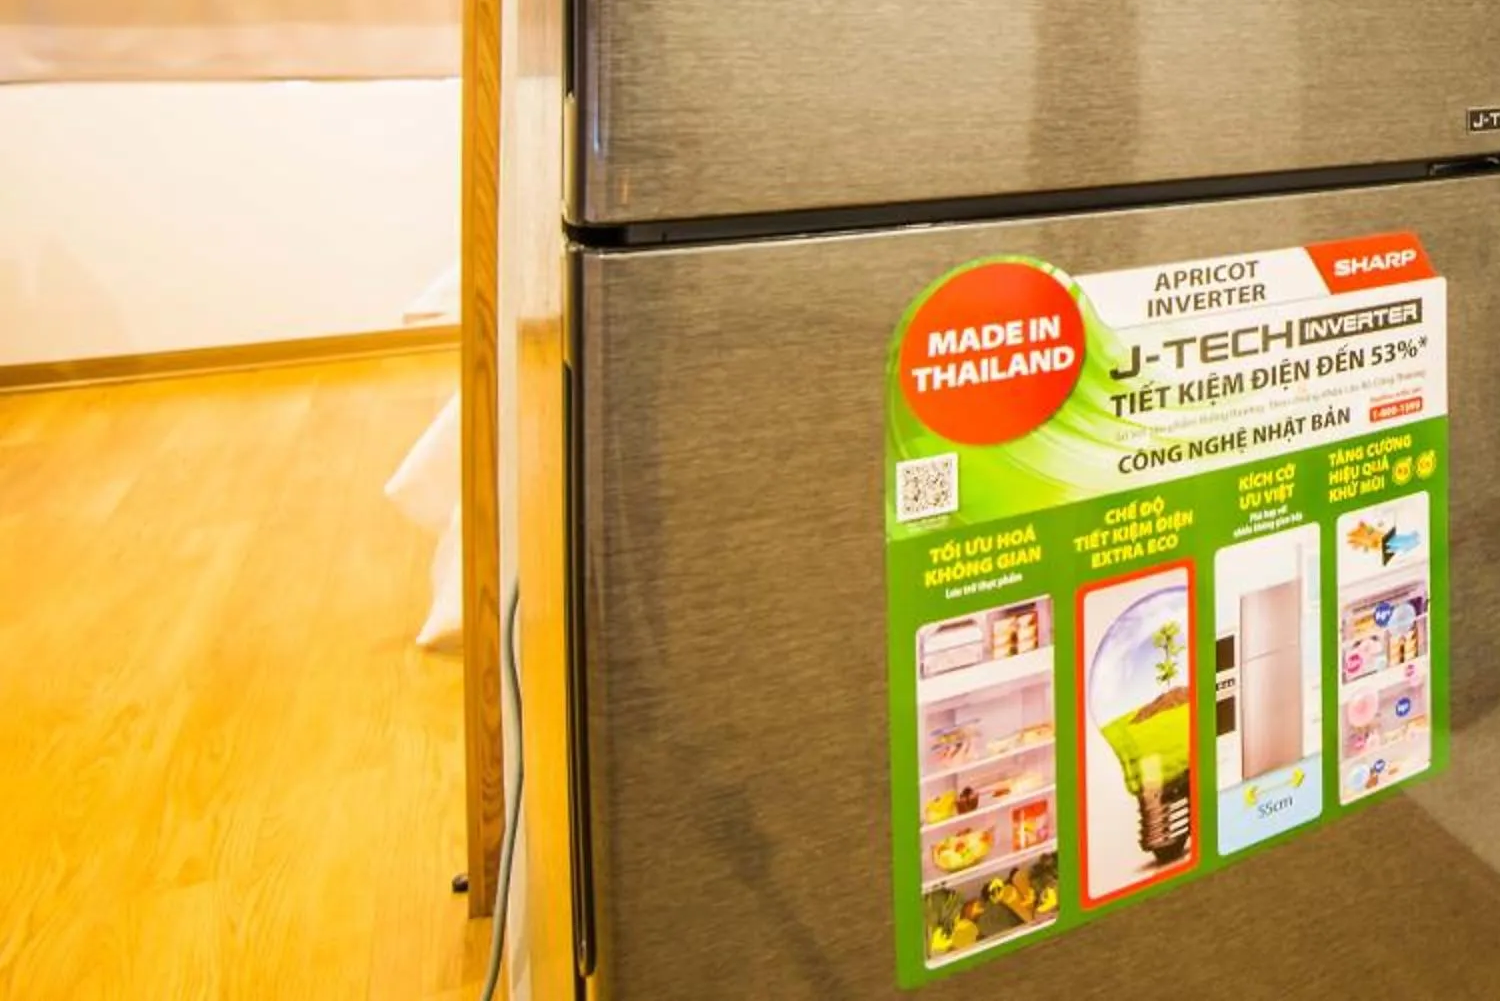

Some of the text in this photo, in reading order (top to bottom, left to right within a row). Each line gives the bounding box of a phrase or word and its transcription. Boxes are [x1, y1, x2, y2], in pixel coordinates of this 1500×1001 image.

[1154, 260, 1260, 292] APRICOT
[1334, 249, 1417, 277] SHARP
[1147, 283, 1266, 318] INVERTER
[928, 315, 1060, 357] MADE IN
[1109, 303, 1419, 381] J-TECH INVERTER
[912, 346, 1075, 393] THAILAND
[1110, 381, 1171, 417] TIẾT
[1178, 372, 1244, 406] KIỆM
[1250, 359, 1310, 391] ĐIỆN
[1316, 344, 1364, 376] ĐẾN
[1118, 405, 1350, 474] CÔNG NGHỆ NHẬT BẢN
[929, 523, 1037, 564] TỐI ƯU HOÁ
[1091, 534, 1179, 570] EXTRA ECO
[924, 546, 1042, 588] KHÔNG GIAN
